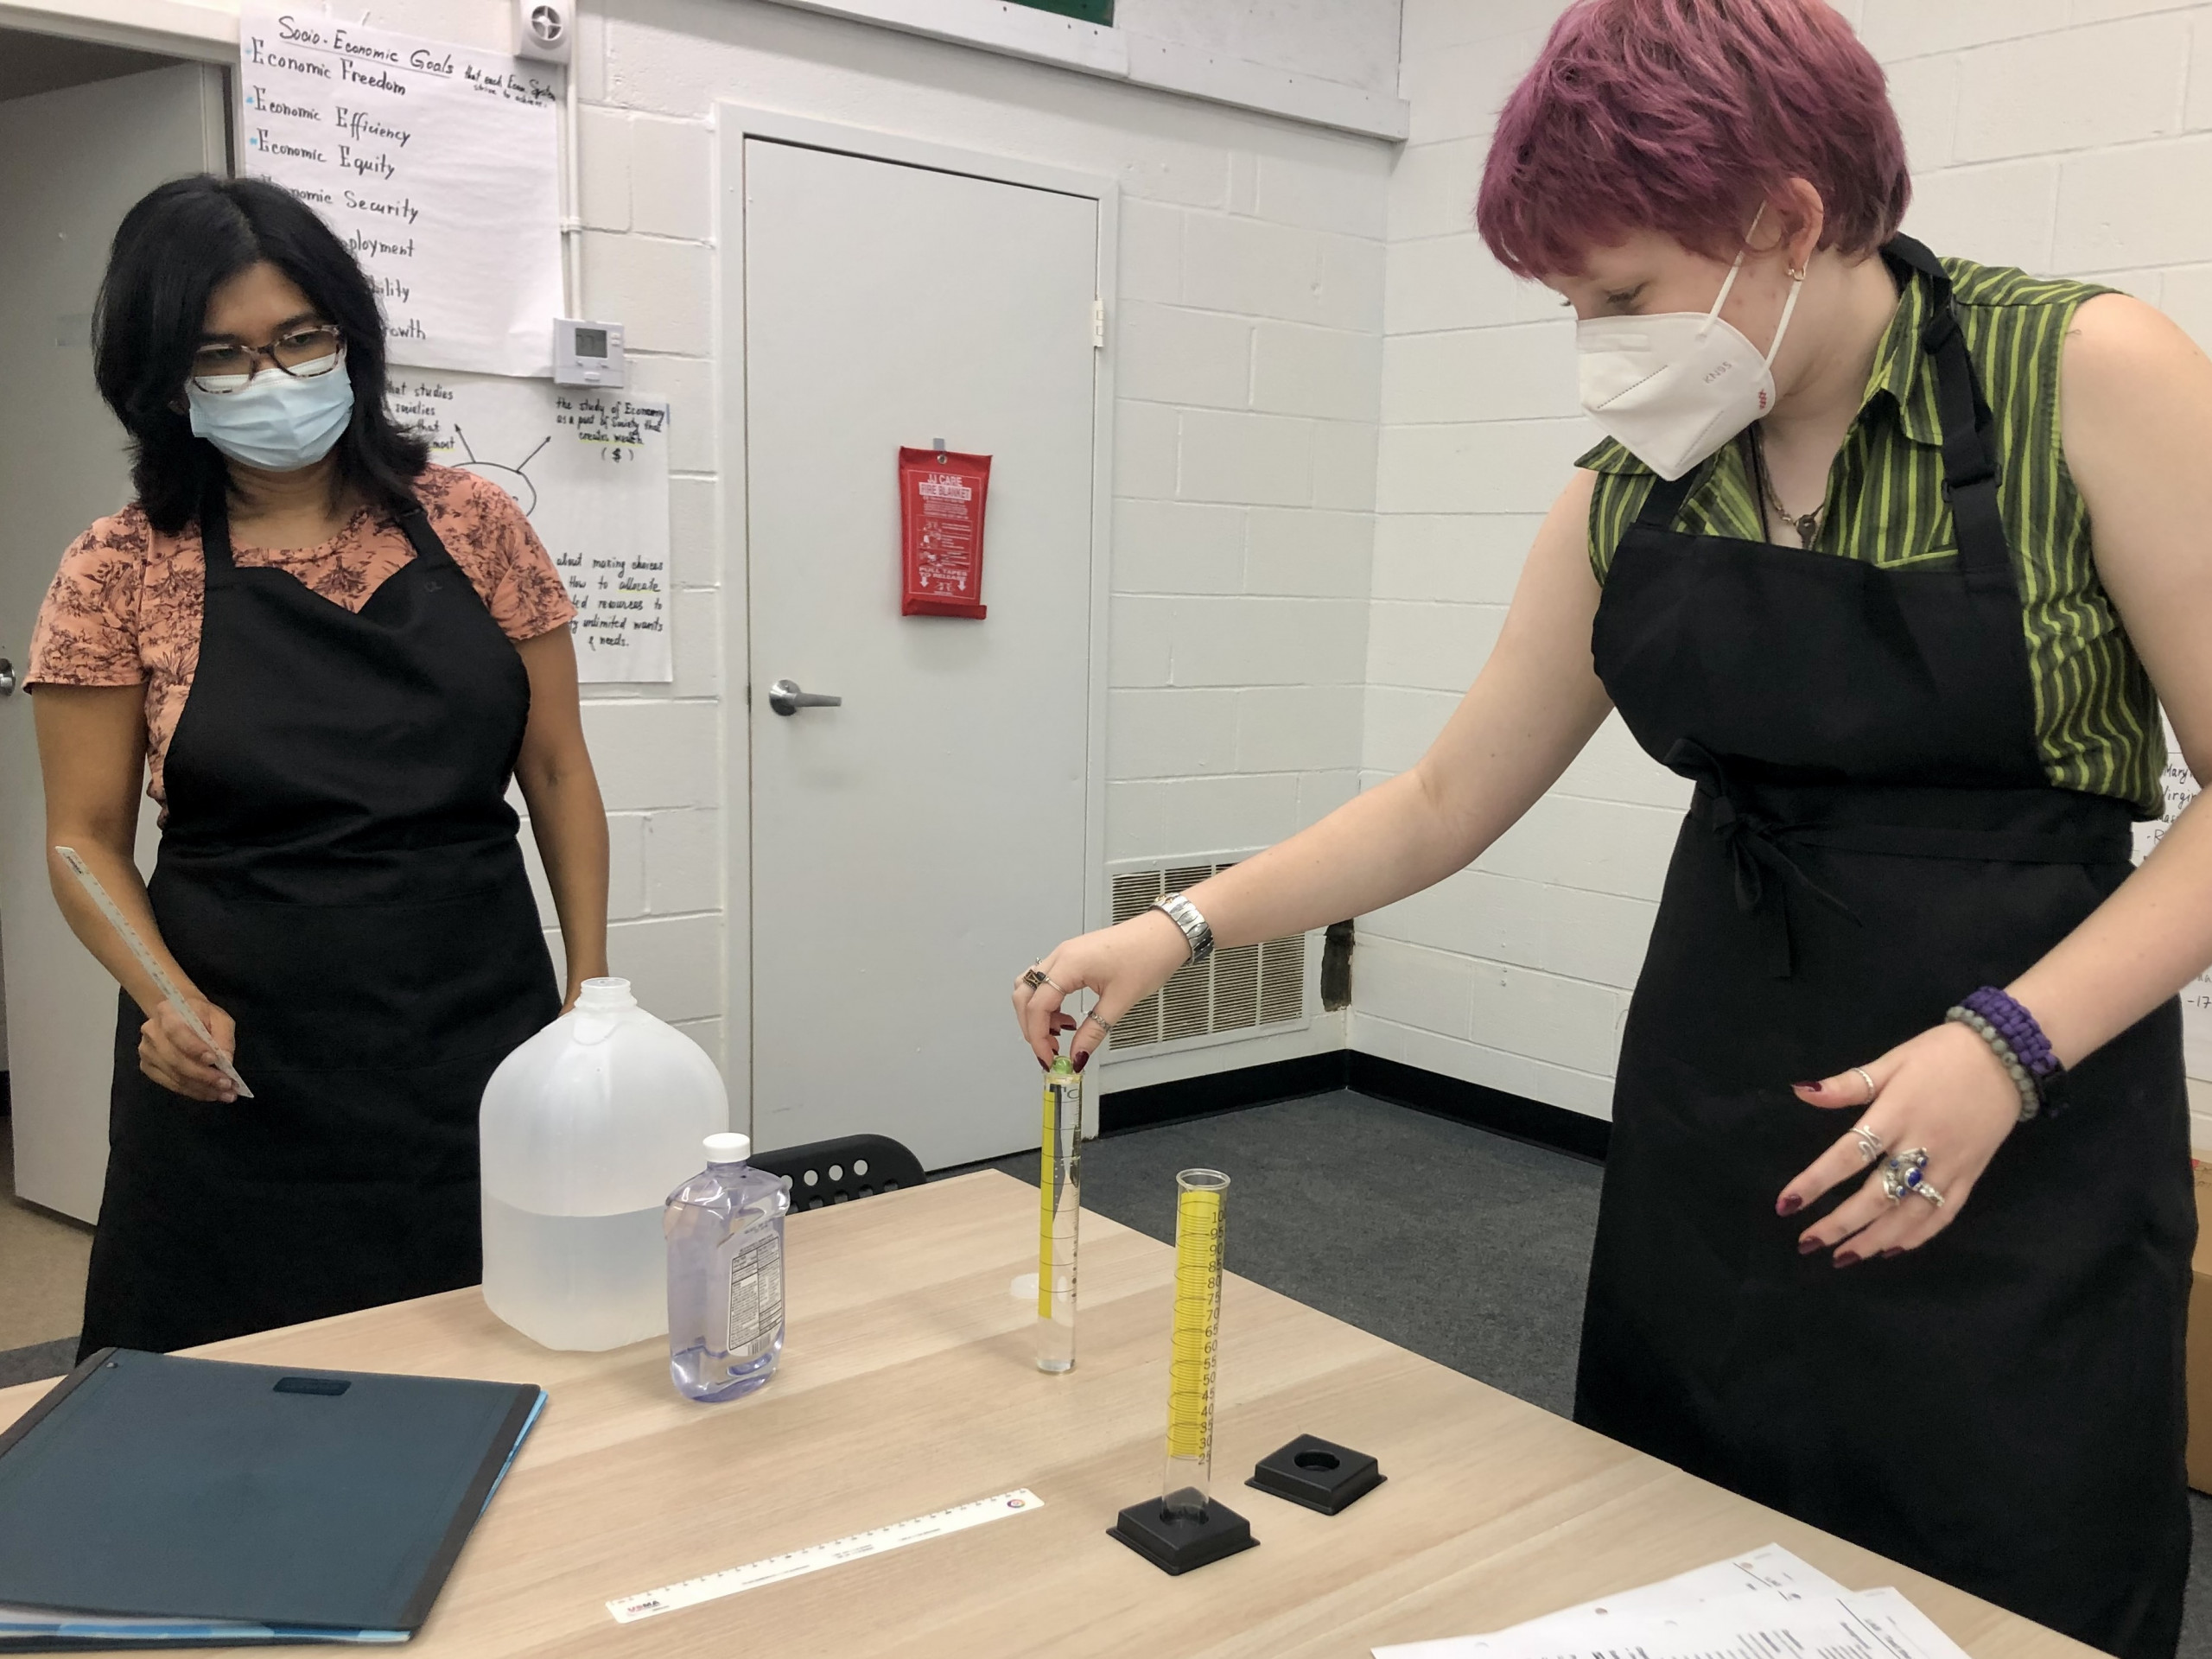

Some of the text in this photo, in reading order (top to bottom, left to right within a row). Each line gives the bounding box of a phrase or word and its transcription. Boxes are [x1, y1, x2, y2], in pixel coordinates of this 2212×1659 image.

[251, 37, 406, 95] Economic Freedom
[410, 49, 454, 74] Goals
[253, 85, 411, 147] Economic Efficiency
[256, 128, 395, 180] Economic Equity
[344, 190, 419, 225] Security
[1703, 361, 1732, 384] KN95
[415, 383, 453, 400] studies
[556, 396, 572, 410] the
[579, 398, 605, 419] study
[611, 401, 621, 420] of
[579, 429, 609, 442] creates
[939, 474, 963, 487] CARE
[556, 551, 664, 579] about making choices
[569, 575, 661, 592] How to allocate
[598, 599, 644, 611] resources
[654, 597, 663, 610] to
[582, 613, 627, 630] unlimited
[633, 616, 664, 632] wants
[1210, 1226, 1224, 1240] 95
[1209, 1243, 1223, 1256] 90
[1208, 1260, 1222, 1273] 85
[1207, 1274, 1221, 1288] 80
[1207, 1292, 1220, 1305] 75
[1206, 1306, 1219, 1321] 70
[1205, 1323, 1218, 1337] 65
[1204, 1339, 1217, 1353] 60
[1204, 1357, 1217, 1370] 55
[1203, 1371, 1216, 1386] 50
[1201, 1387, 1215, 1402] 45
[1201, 1402, 1214, 1417] 40
